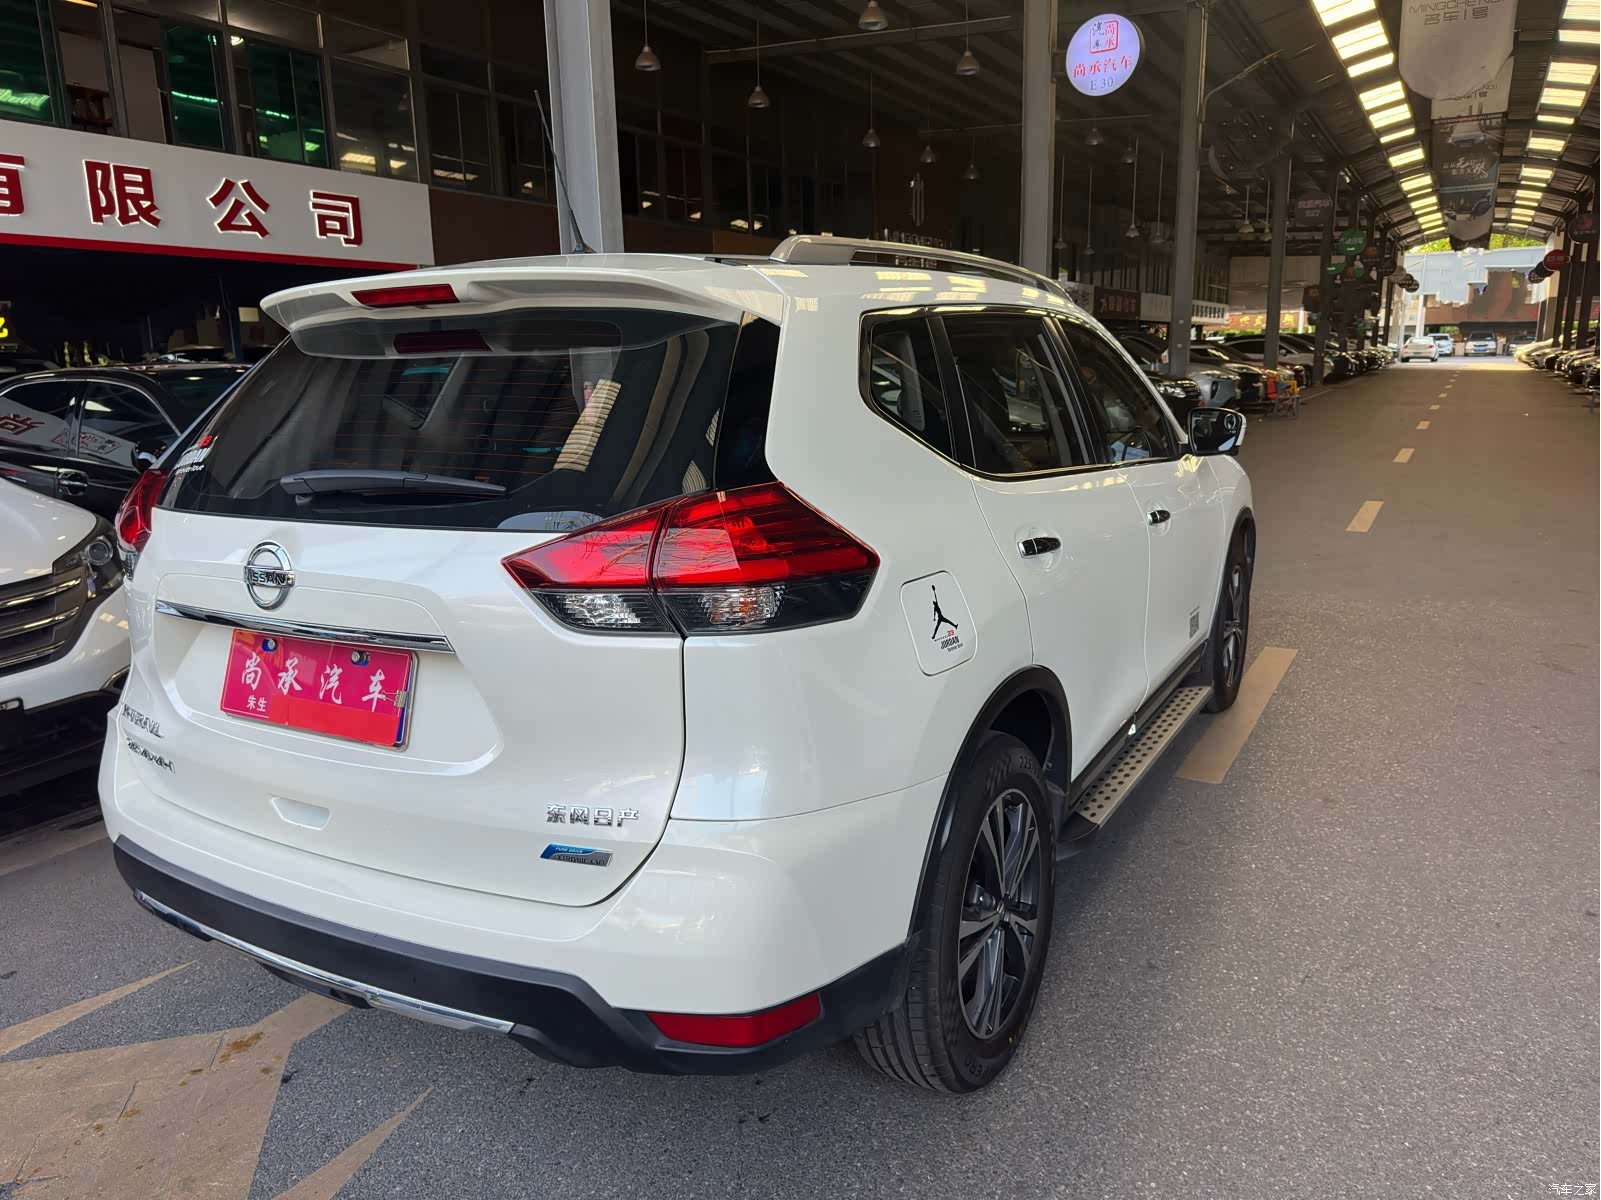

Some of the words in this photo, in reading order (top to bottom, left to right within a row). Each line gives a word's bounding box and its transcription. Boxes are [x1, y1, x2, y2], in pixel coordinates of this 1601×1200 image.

[1073, 55, 1133, 79] 尚承汽车
[241, 652, 388, 713] 尚承汽车
[246, 694, 267, 713] 朱生
[546, 803, 639, 828] 东风日产
